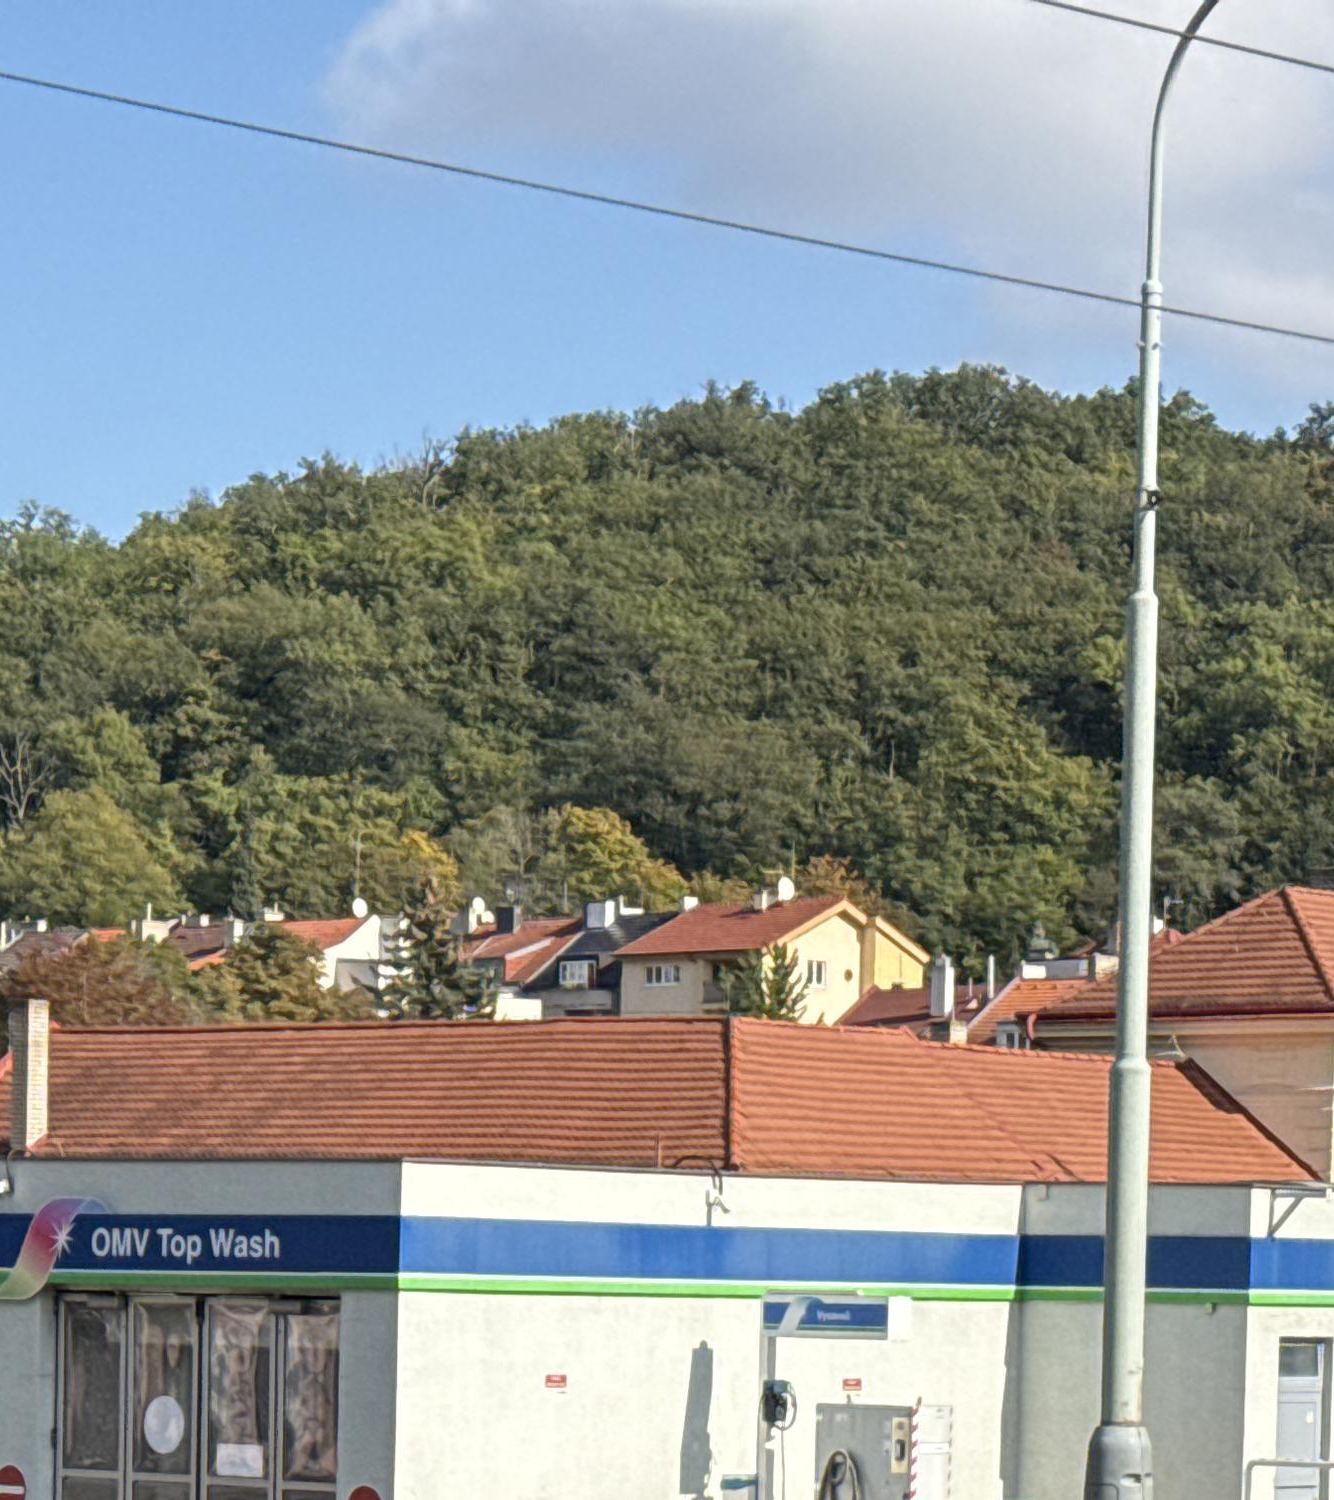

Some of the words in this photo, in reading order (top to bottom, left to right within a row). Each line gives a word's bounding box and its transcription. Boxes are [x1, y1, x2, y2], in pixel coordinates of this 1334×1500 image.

[91, 1227, 150, 1258] OMV
[156, 1227, 202, 1265] Top
[209, 1228, 280, 1258] Wash
